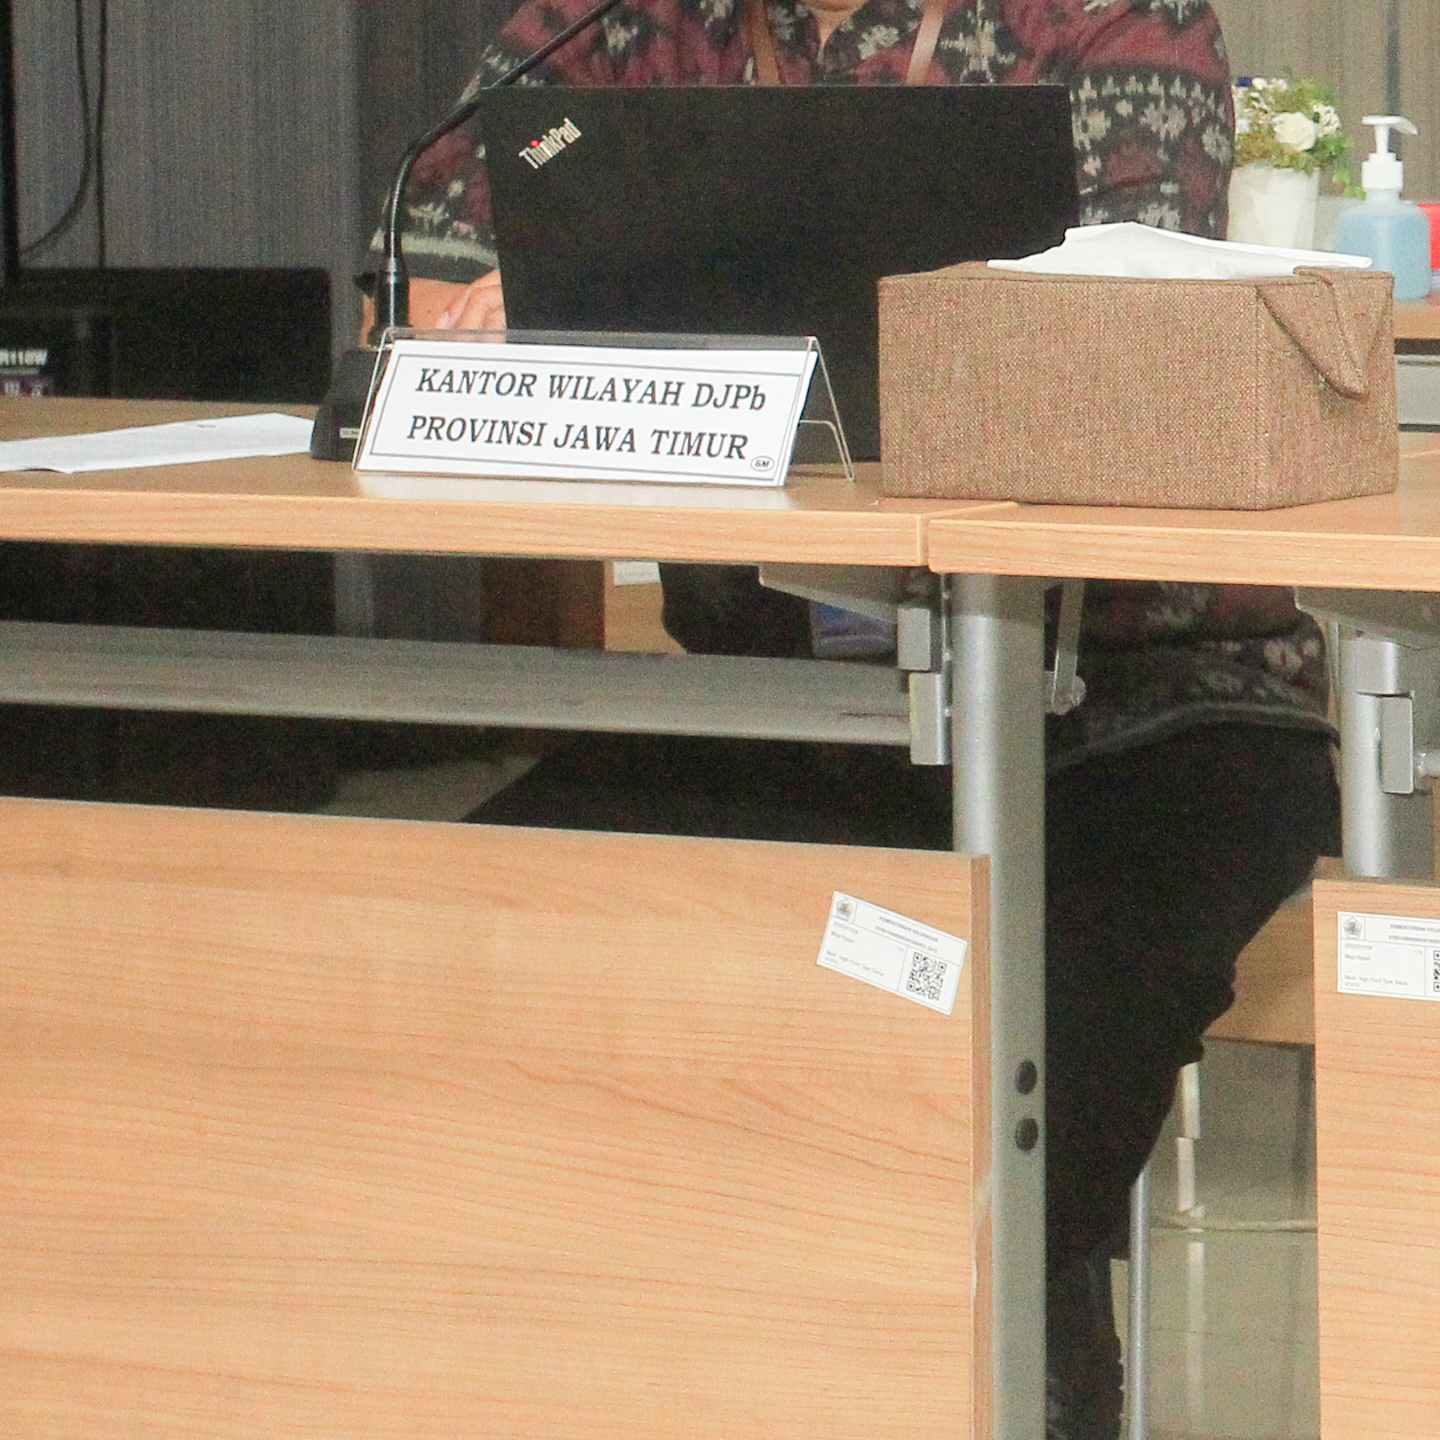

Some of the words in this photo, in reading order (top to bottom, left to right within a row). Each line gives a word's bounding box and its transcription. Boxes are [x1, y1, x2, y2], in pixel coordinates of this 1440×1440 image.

[518, 117, 582, 169] ThinkPad
[416, 368, 539, 398] KANTOR
[548, 375, 683, 407] WILAYAH
[692, 383, 766, 411] DJPb
[407, 416, 547, 447] PROVINSI
[553, 423, 637, 452] JAWA
[650, 429, 749, 460] TIMUR
